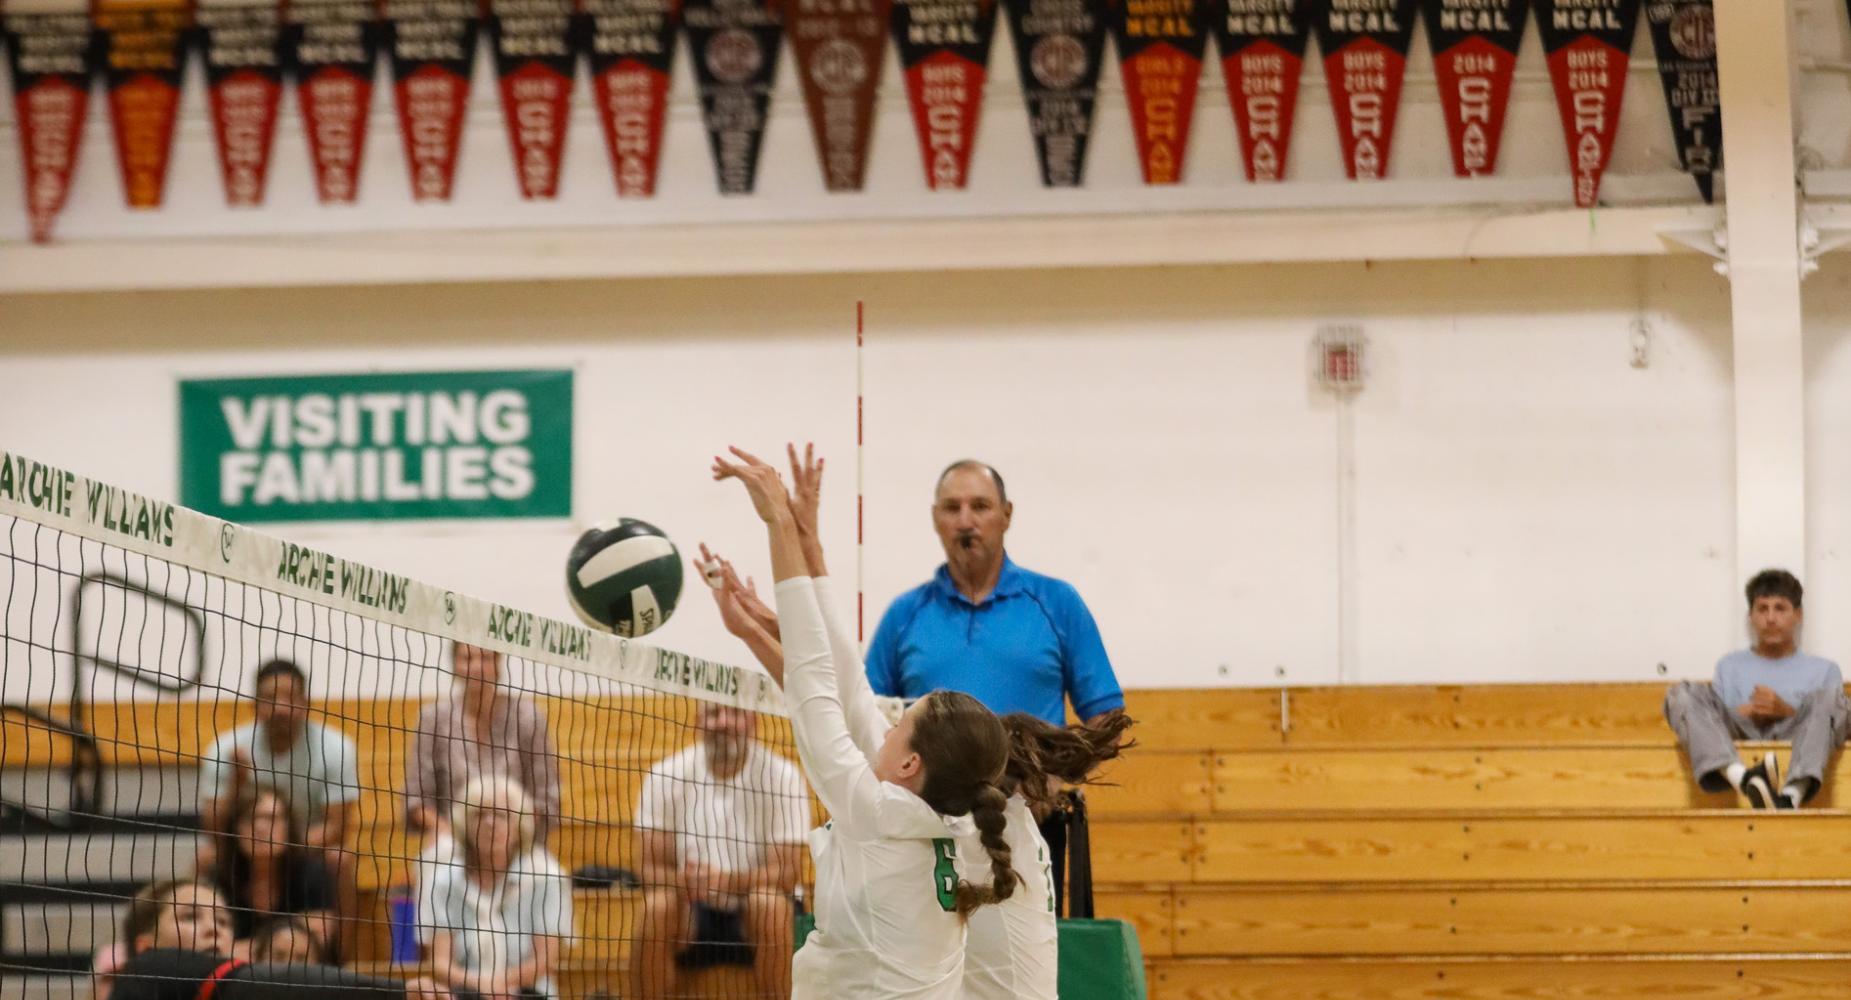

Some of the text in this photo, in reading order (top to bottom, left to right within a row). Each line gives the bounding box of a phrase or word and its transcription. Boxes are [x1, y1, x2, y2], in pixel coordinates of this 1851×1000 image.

[1241, 54, 1282, 75] BOYS
[1343, 51, 1386, 71] BOYS
[1453, 54, 1496, 73] 2014
[1567, 51, 1608, 69] BOYS
[1241, 76, 1283, 95] 2014
[1344, 73, 1387, 92] 2014
[1568, 71, 1610, 90] 2014
[220, 391, 530, 449] VISITING
[0, 452, 75, 518] ARCHIE
[220, 447, 535, 505] FAMILIES
[932, 837, 959, 912] 6
